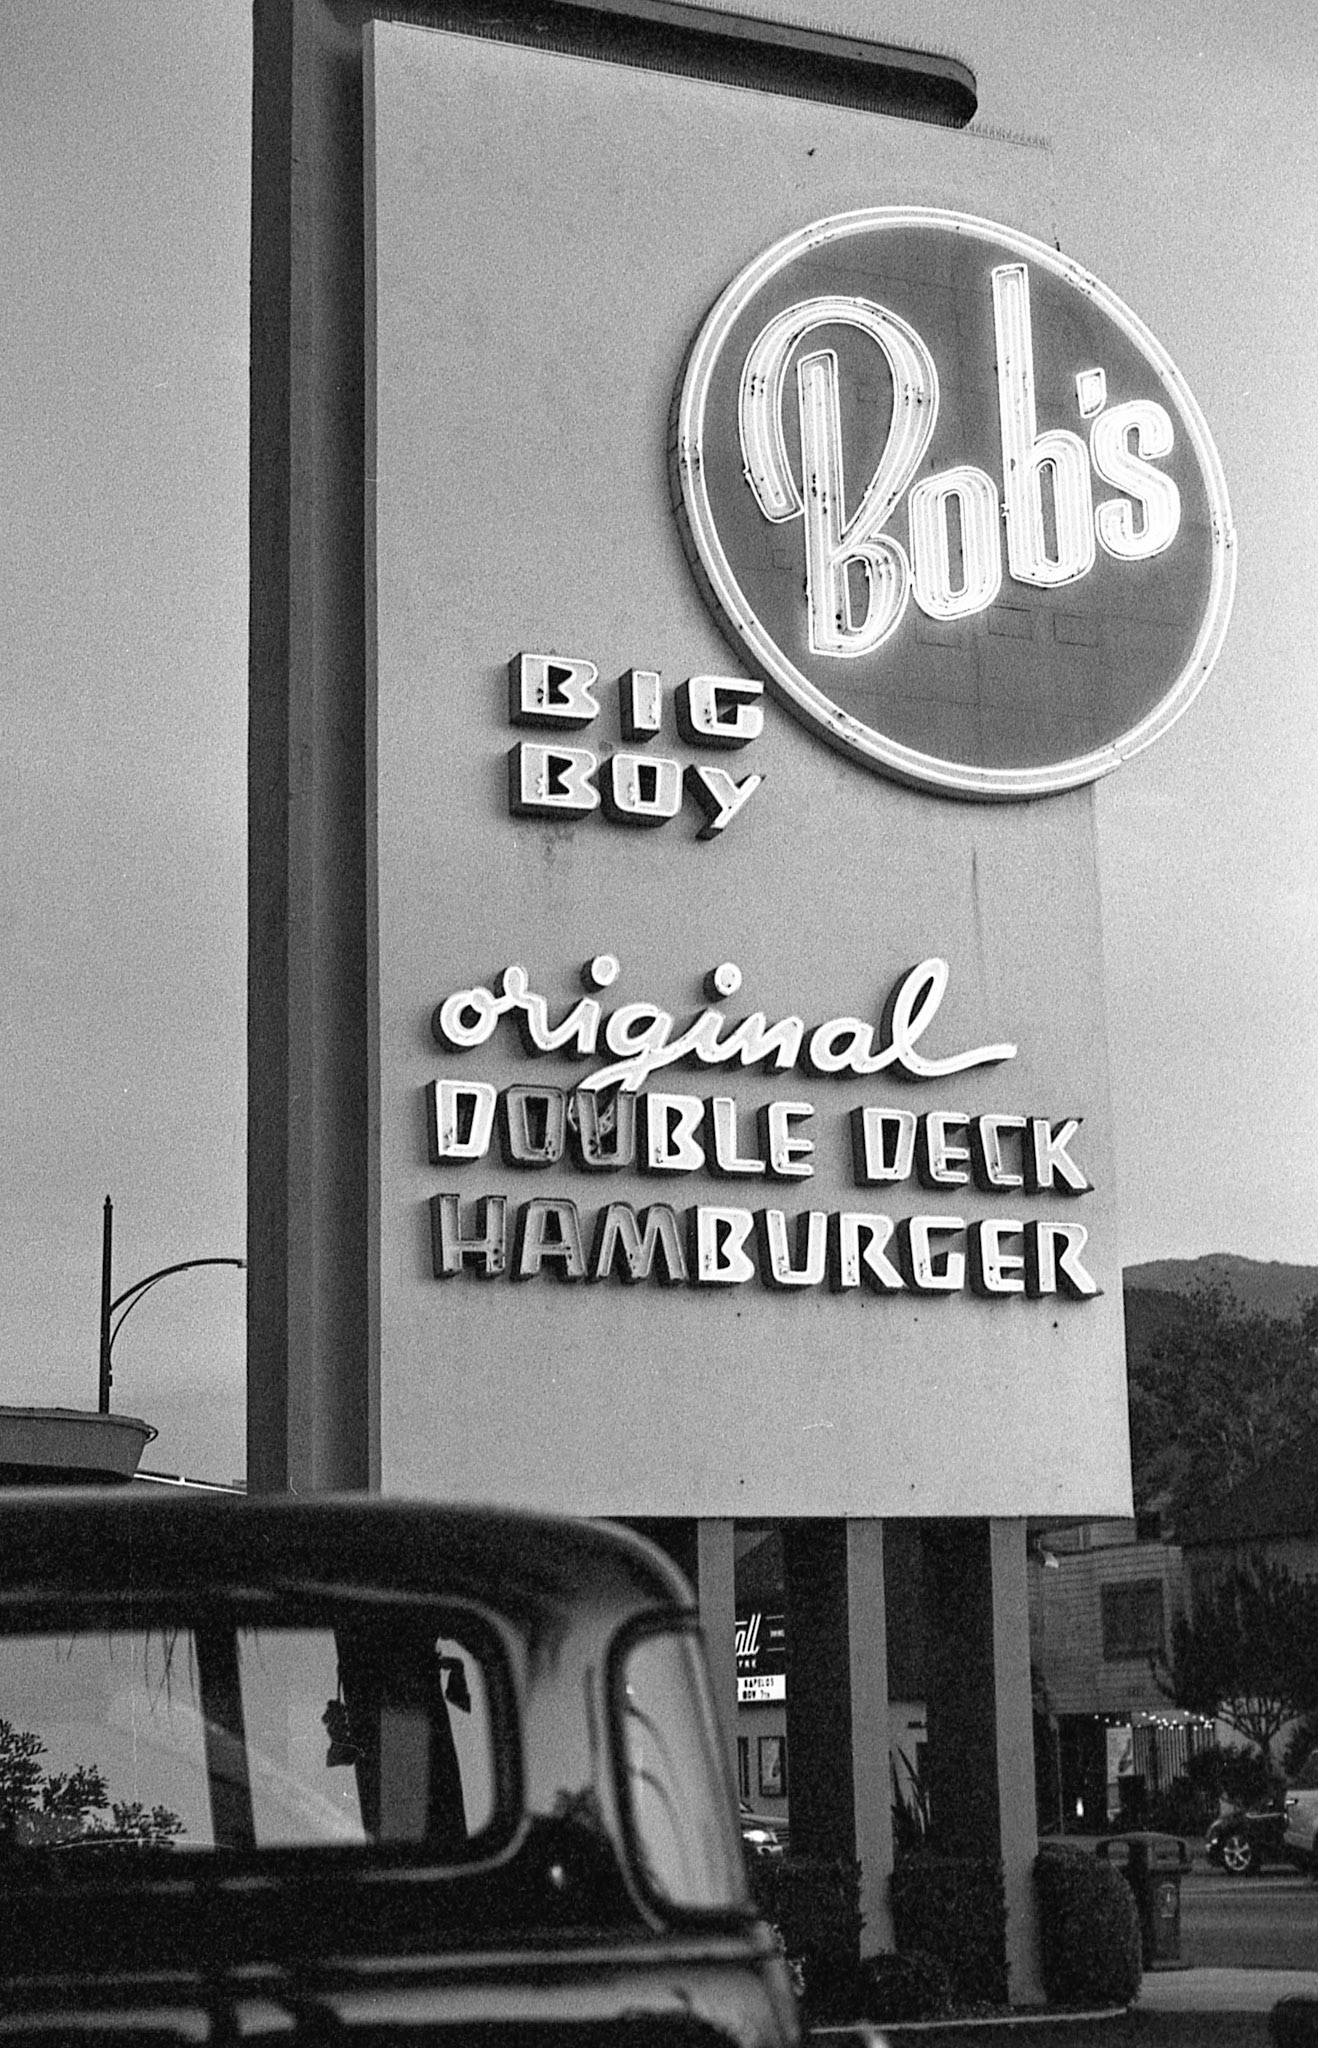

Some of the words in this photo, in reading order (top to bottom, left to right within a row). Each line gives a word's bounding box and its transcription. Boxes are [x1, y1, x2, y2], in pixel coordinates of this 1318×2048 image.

[738, 264, 1181, 657] Bob's
[513, 653, 764, 742] BIG
[513, 743, 766, 838] BOY
[439, 957, 1017, 1091] original
[434, 1079, 815, 1177] DOUBLE
[860, 1106, 1093, 1192] DECK
[436, 1194, 1100, 1295] HAMBURGER
